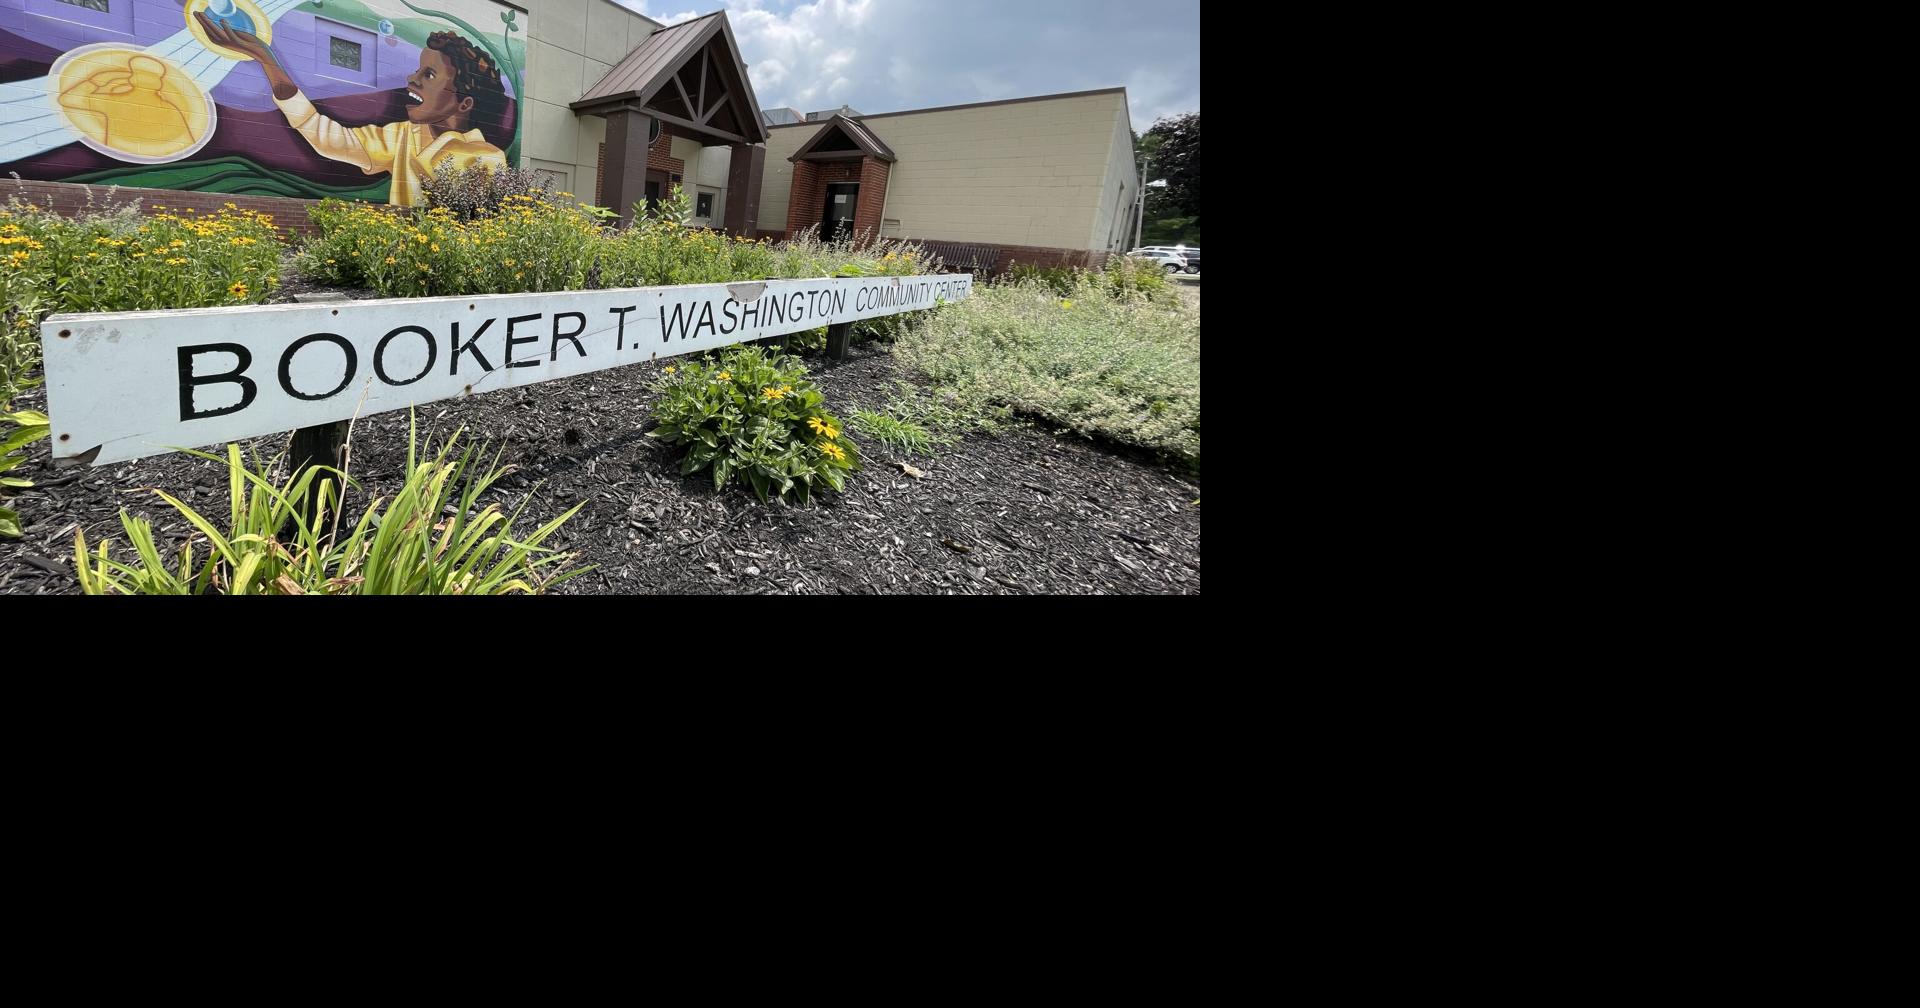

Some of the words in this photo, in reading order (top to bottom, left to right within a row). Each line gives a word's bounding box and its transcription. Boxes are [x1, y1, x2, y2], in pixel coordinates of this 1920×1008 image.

[177, 311, 587, 422] BOOKER
[609, 305, 640, 351] T.
[660, 288, 846, 343] WASHINGTON
[856, 282, 933, 312] COMMUNITY
[933, 280, 967, 301] CENTER
